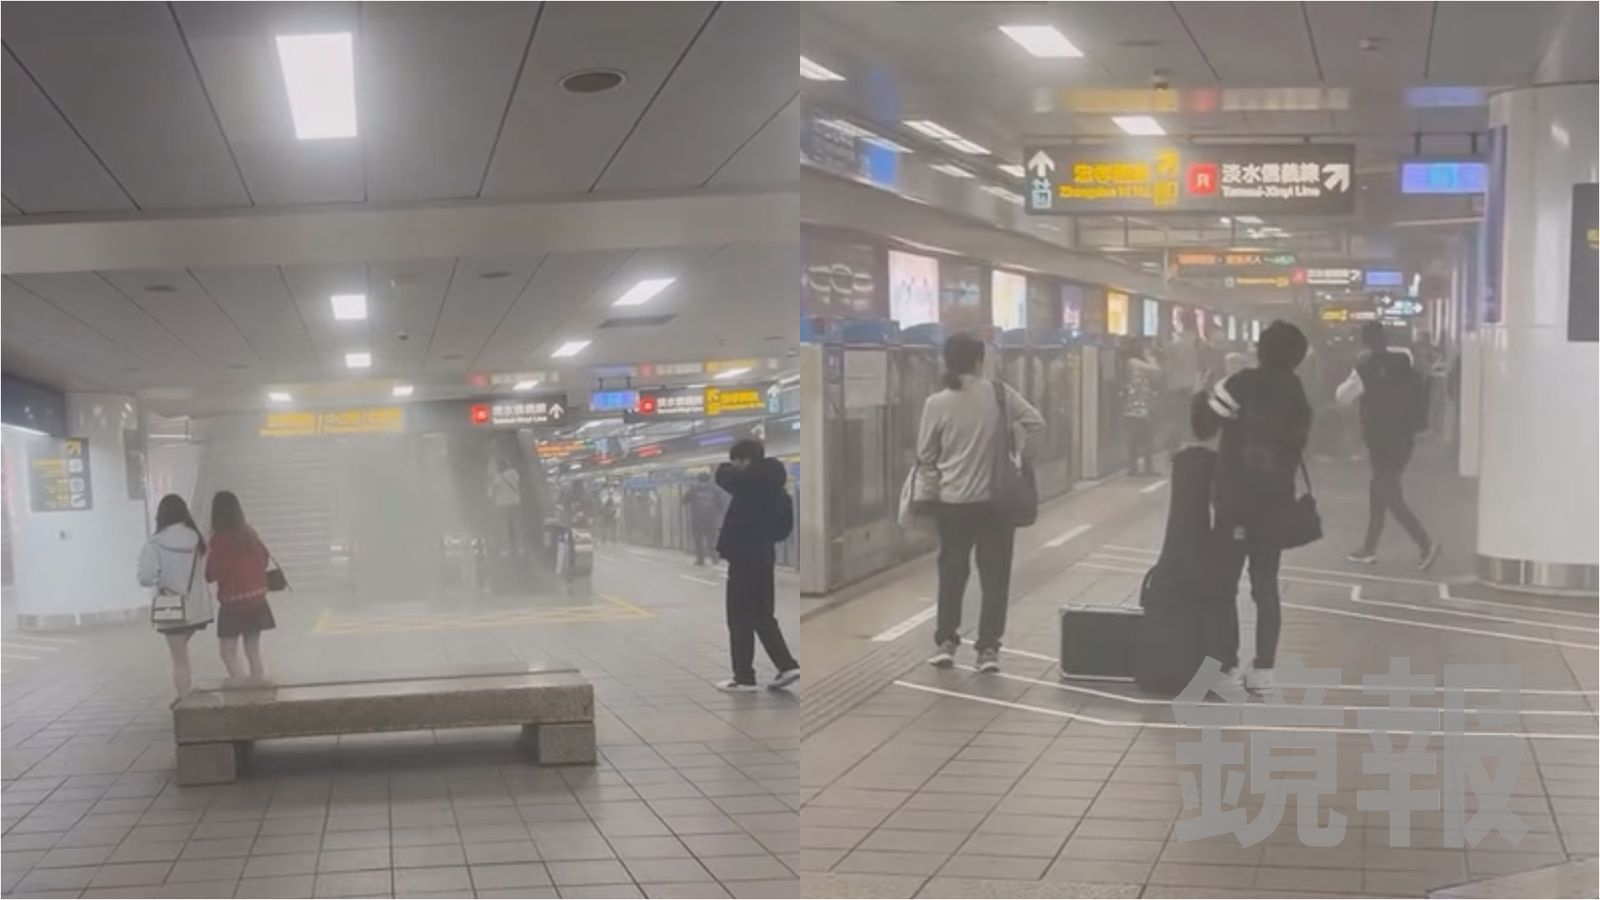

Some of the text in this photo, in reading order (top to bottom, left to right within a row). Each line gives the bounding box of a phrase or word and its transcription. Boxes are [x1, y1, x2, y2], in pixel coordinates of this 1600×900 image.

[1222, 162, 1320, 184] 淡水信義線
